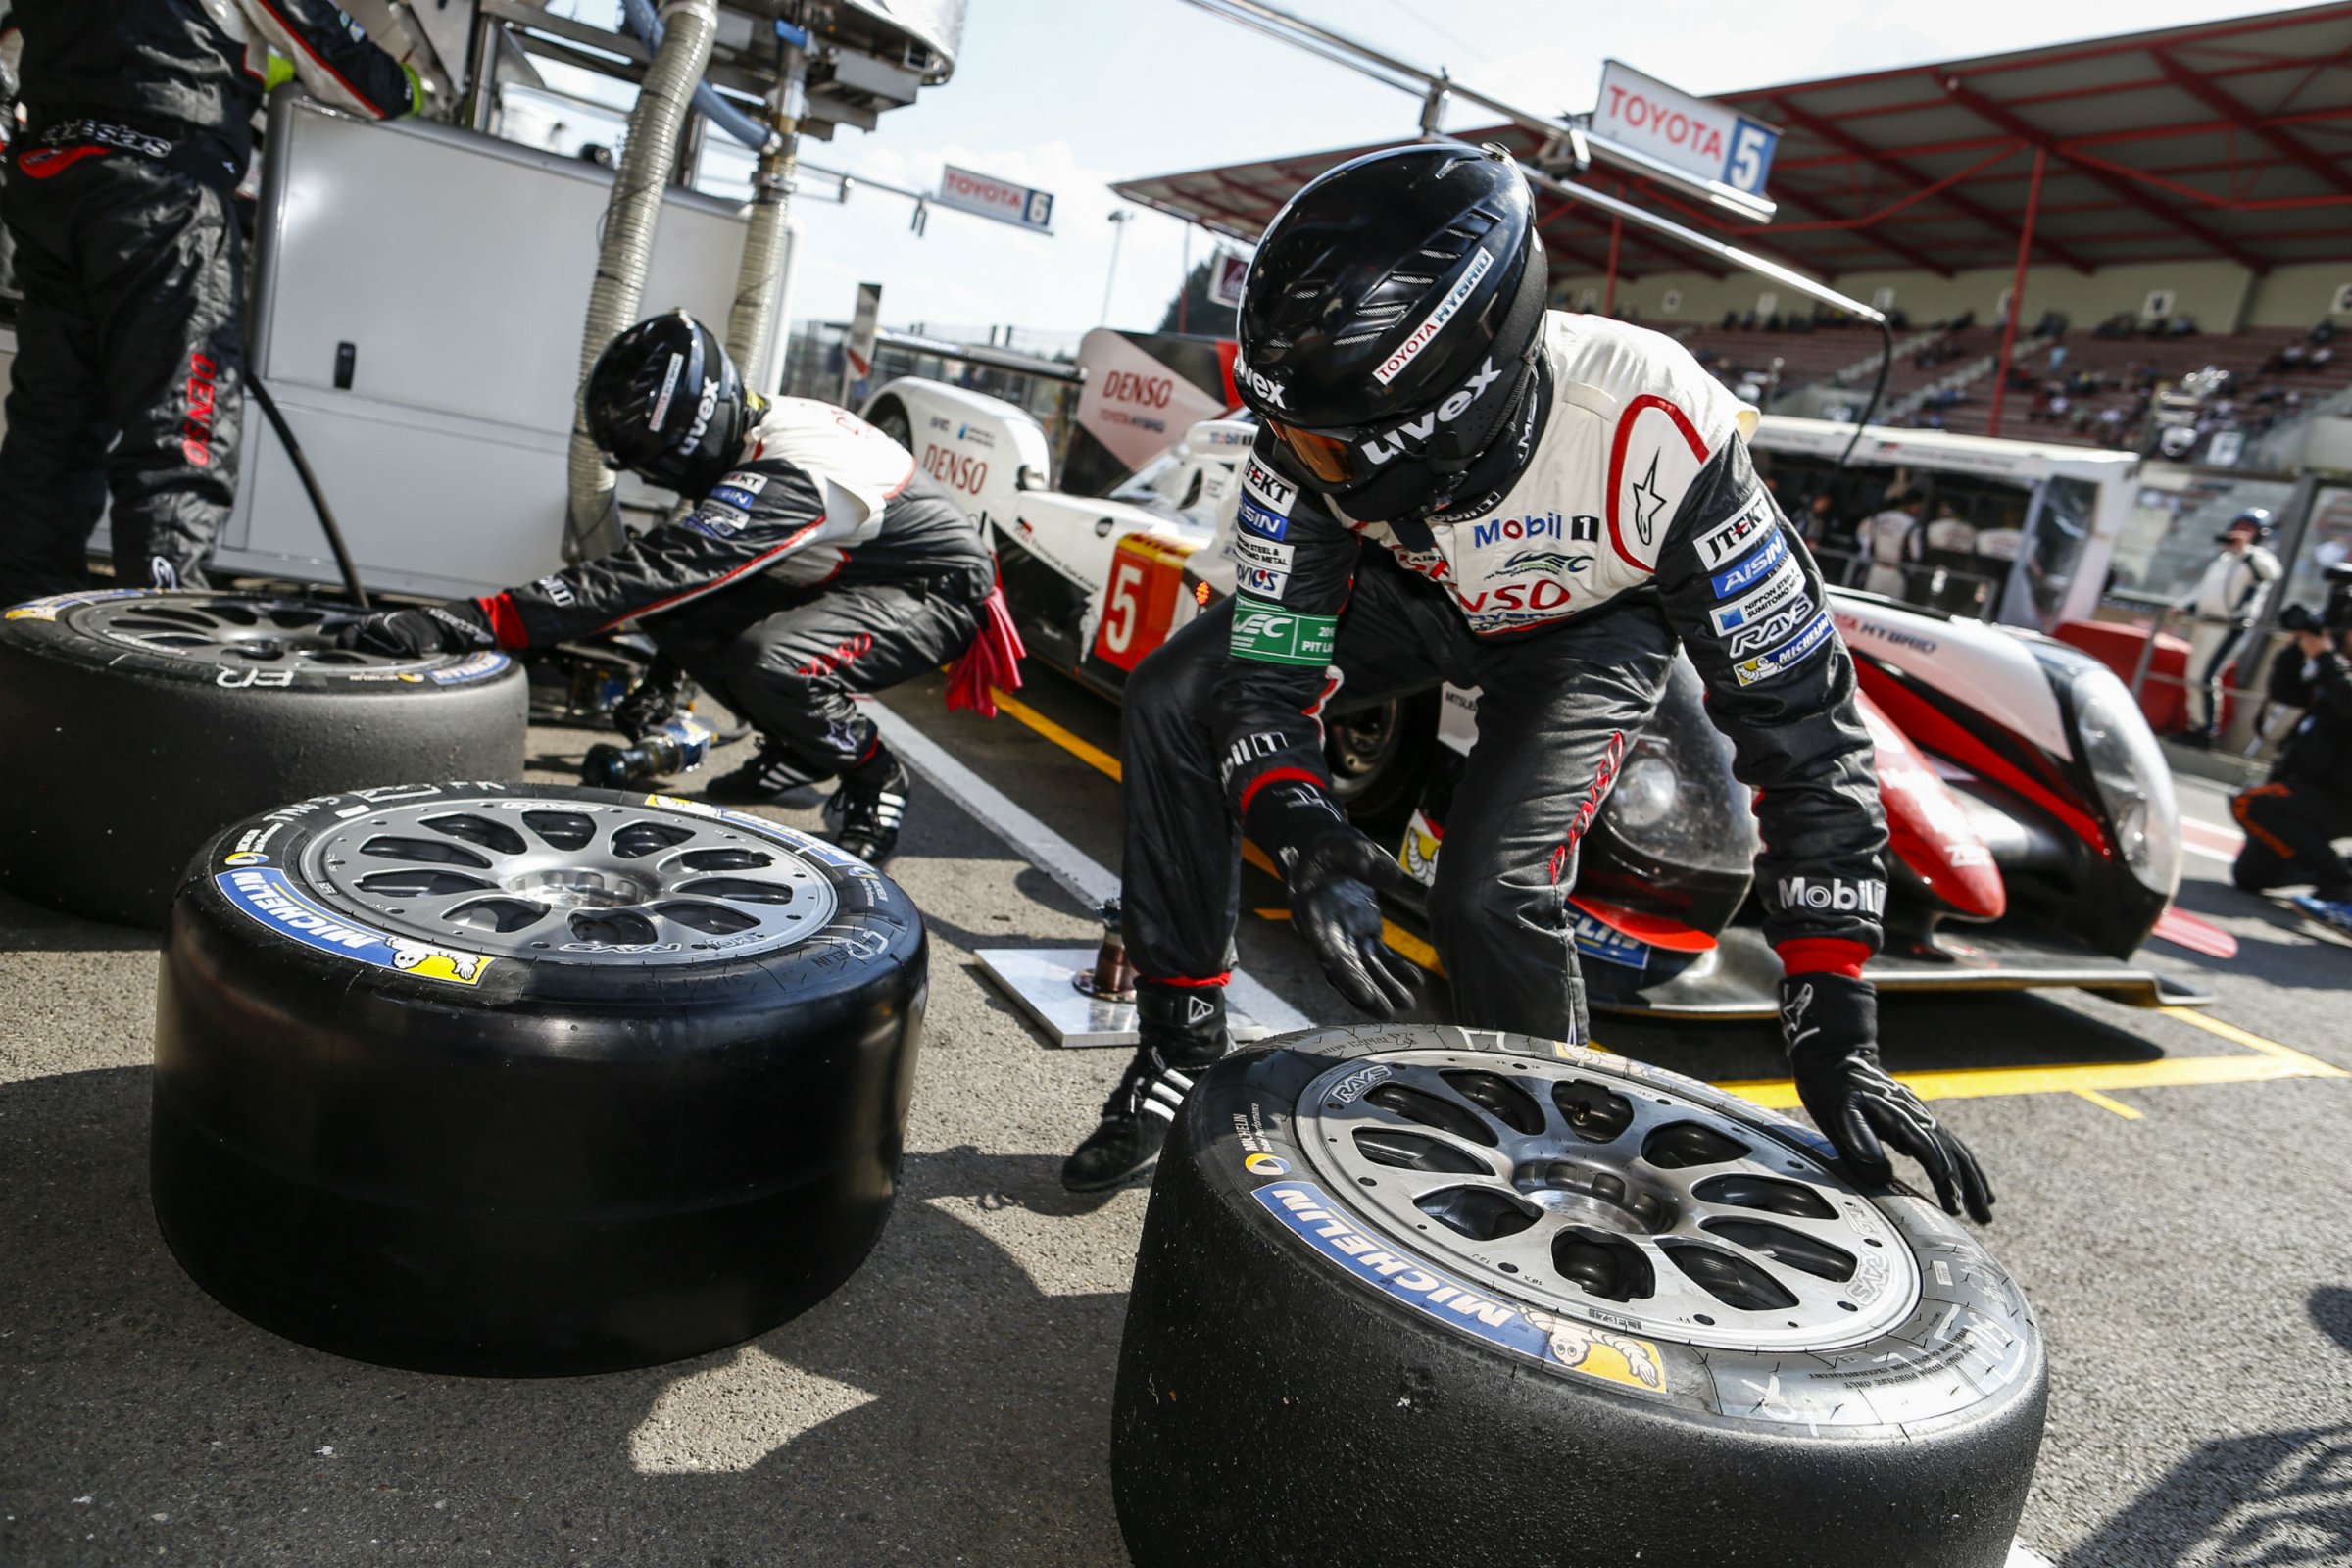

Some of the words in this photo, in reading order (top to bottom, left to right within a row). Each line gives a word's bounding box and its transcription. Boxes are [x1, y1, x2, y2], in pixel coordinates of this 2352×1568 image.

[1608, 85, 1722, 160] TOYOTA
[1730, 127, 1767, 194] 5
[947, 172, 1021, 208] TOYOTA
[1028, 191, 1051, 224] 6
[1376, 322, 1438, 379] TOYOTA
[1434, 251, 1491, 324] HYBRID
[182, 353, 215, 466] DENSO
[1102, 369, 1173, 409] DENSO
[1361, 356, 1502, 465] uvex
[677, 376, 720, 456] uvex
[923, 443, 988, 495] DENSO
[1473, 511, 1561, 549] Mobil
[1706, 498, 1767, 563] JTEKT
[1724, 536, 1785, 592] AISIN
[1106, 564, 1144, 654] 5
[1744, 587, 1776, 612] NIPPON
[1747, 587, 1789, 618] SUMITOMO
[1301, 640, 1322, 652] PIT
[1731, 595, 1812, 658] RAYS
[1778, 616, 1831, 663] MICHELIN
[1861, 622, 1938, 655] HYBRID
[231, 871, 379, 949] MICHELIN
[1778, 877, 1874, 911] Mobil
[1333, 1066, 1391, 1102] RAYS
[1233, 1113, 1259, 1152] MICHELIN
[1251, 1102, 1268, 1136] Performance
[1272, 1189, 1516, 1327] MICHELIN
[1844, 1380, 1872, 1390] ONLY
